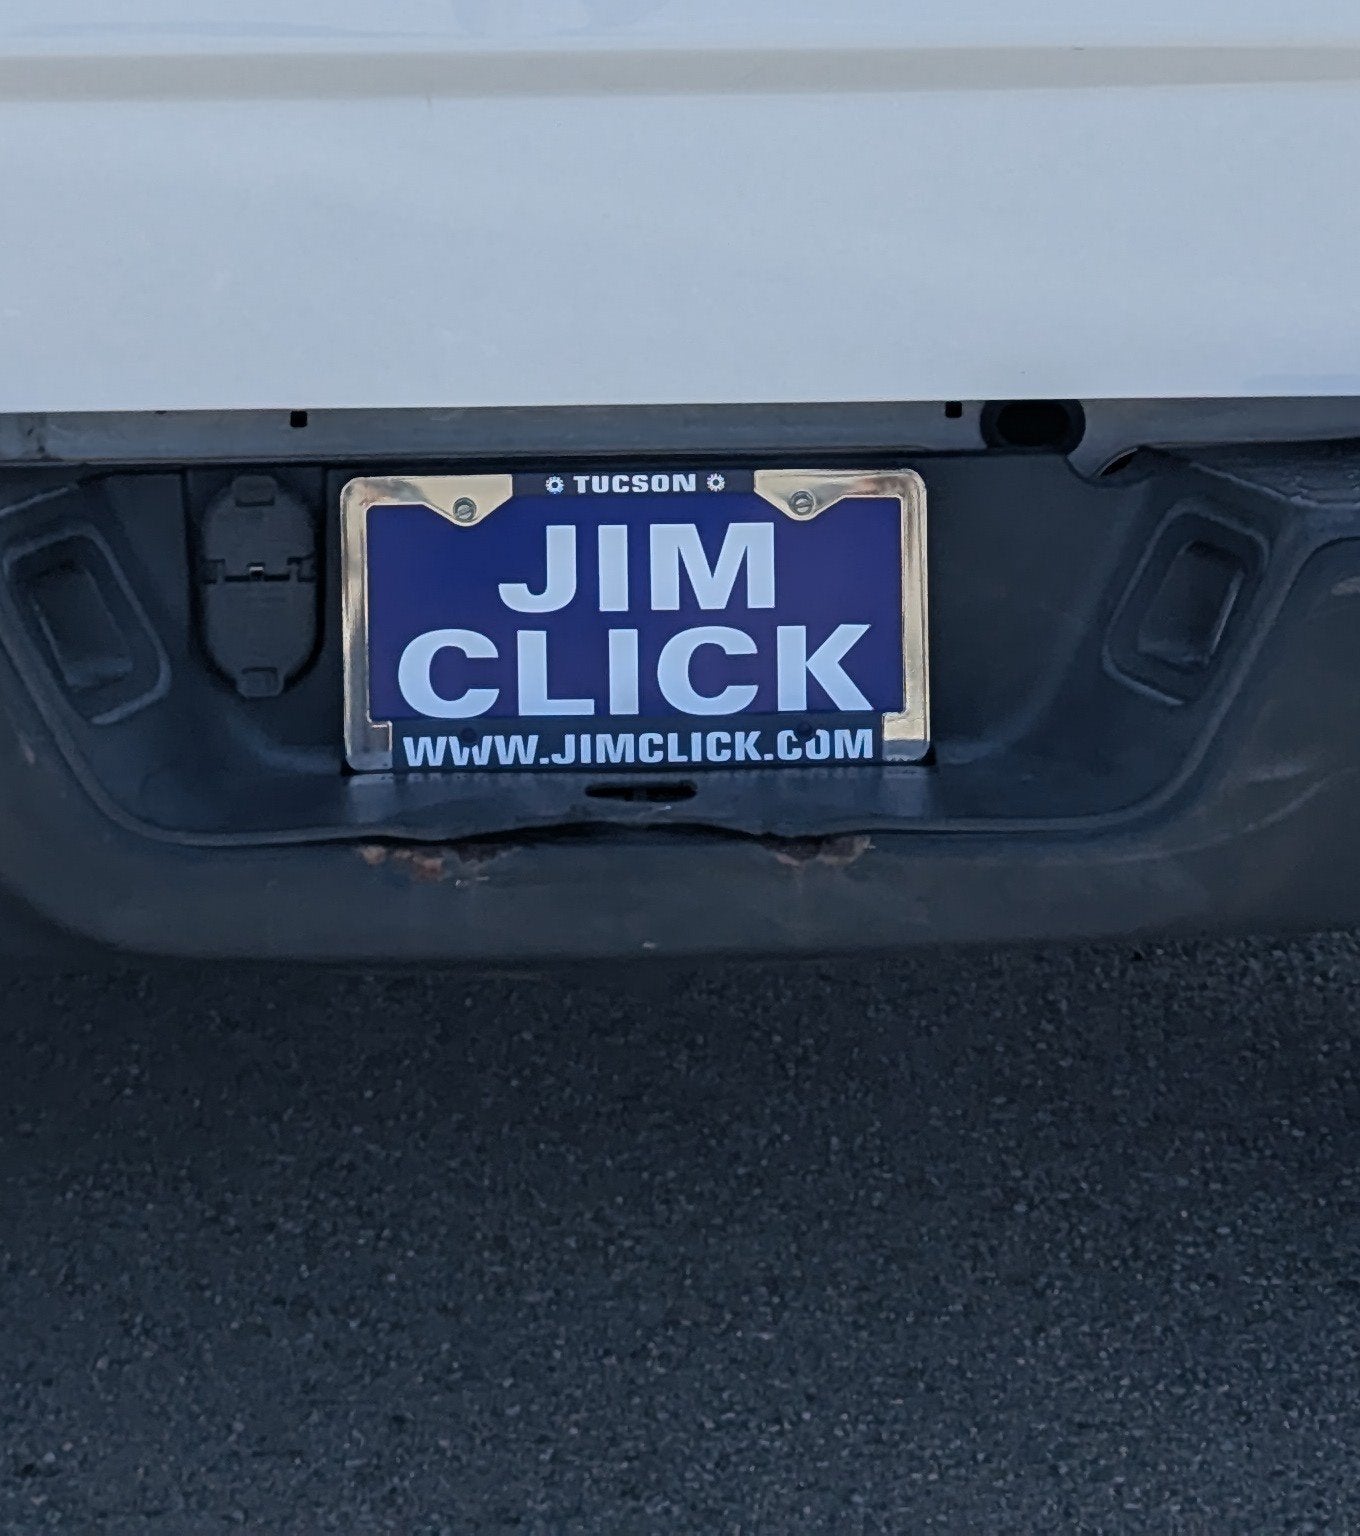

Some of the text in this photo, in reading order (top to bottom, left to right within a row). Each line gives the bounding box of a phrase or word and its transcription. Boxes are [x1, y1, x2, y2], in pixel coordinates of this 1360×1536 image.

[573, 473, 697, 493] TUCSON
[498, 522, 776, 613] JIM
[397, 623, 874, 718] CLICK
[402, 728, 874, 767] WWW.JIMCLICK.COM
